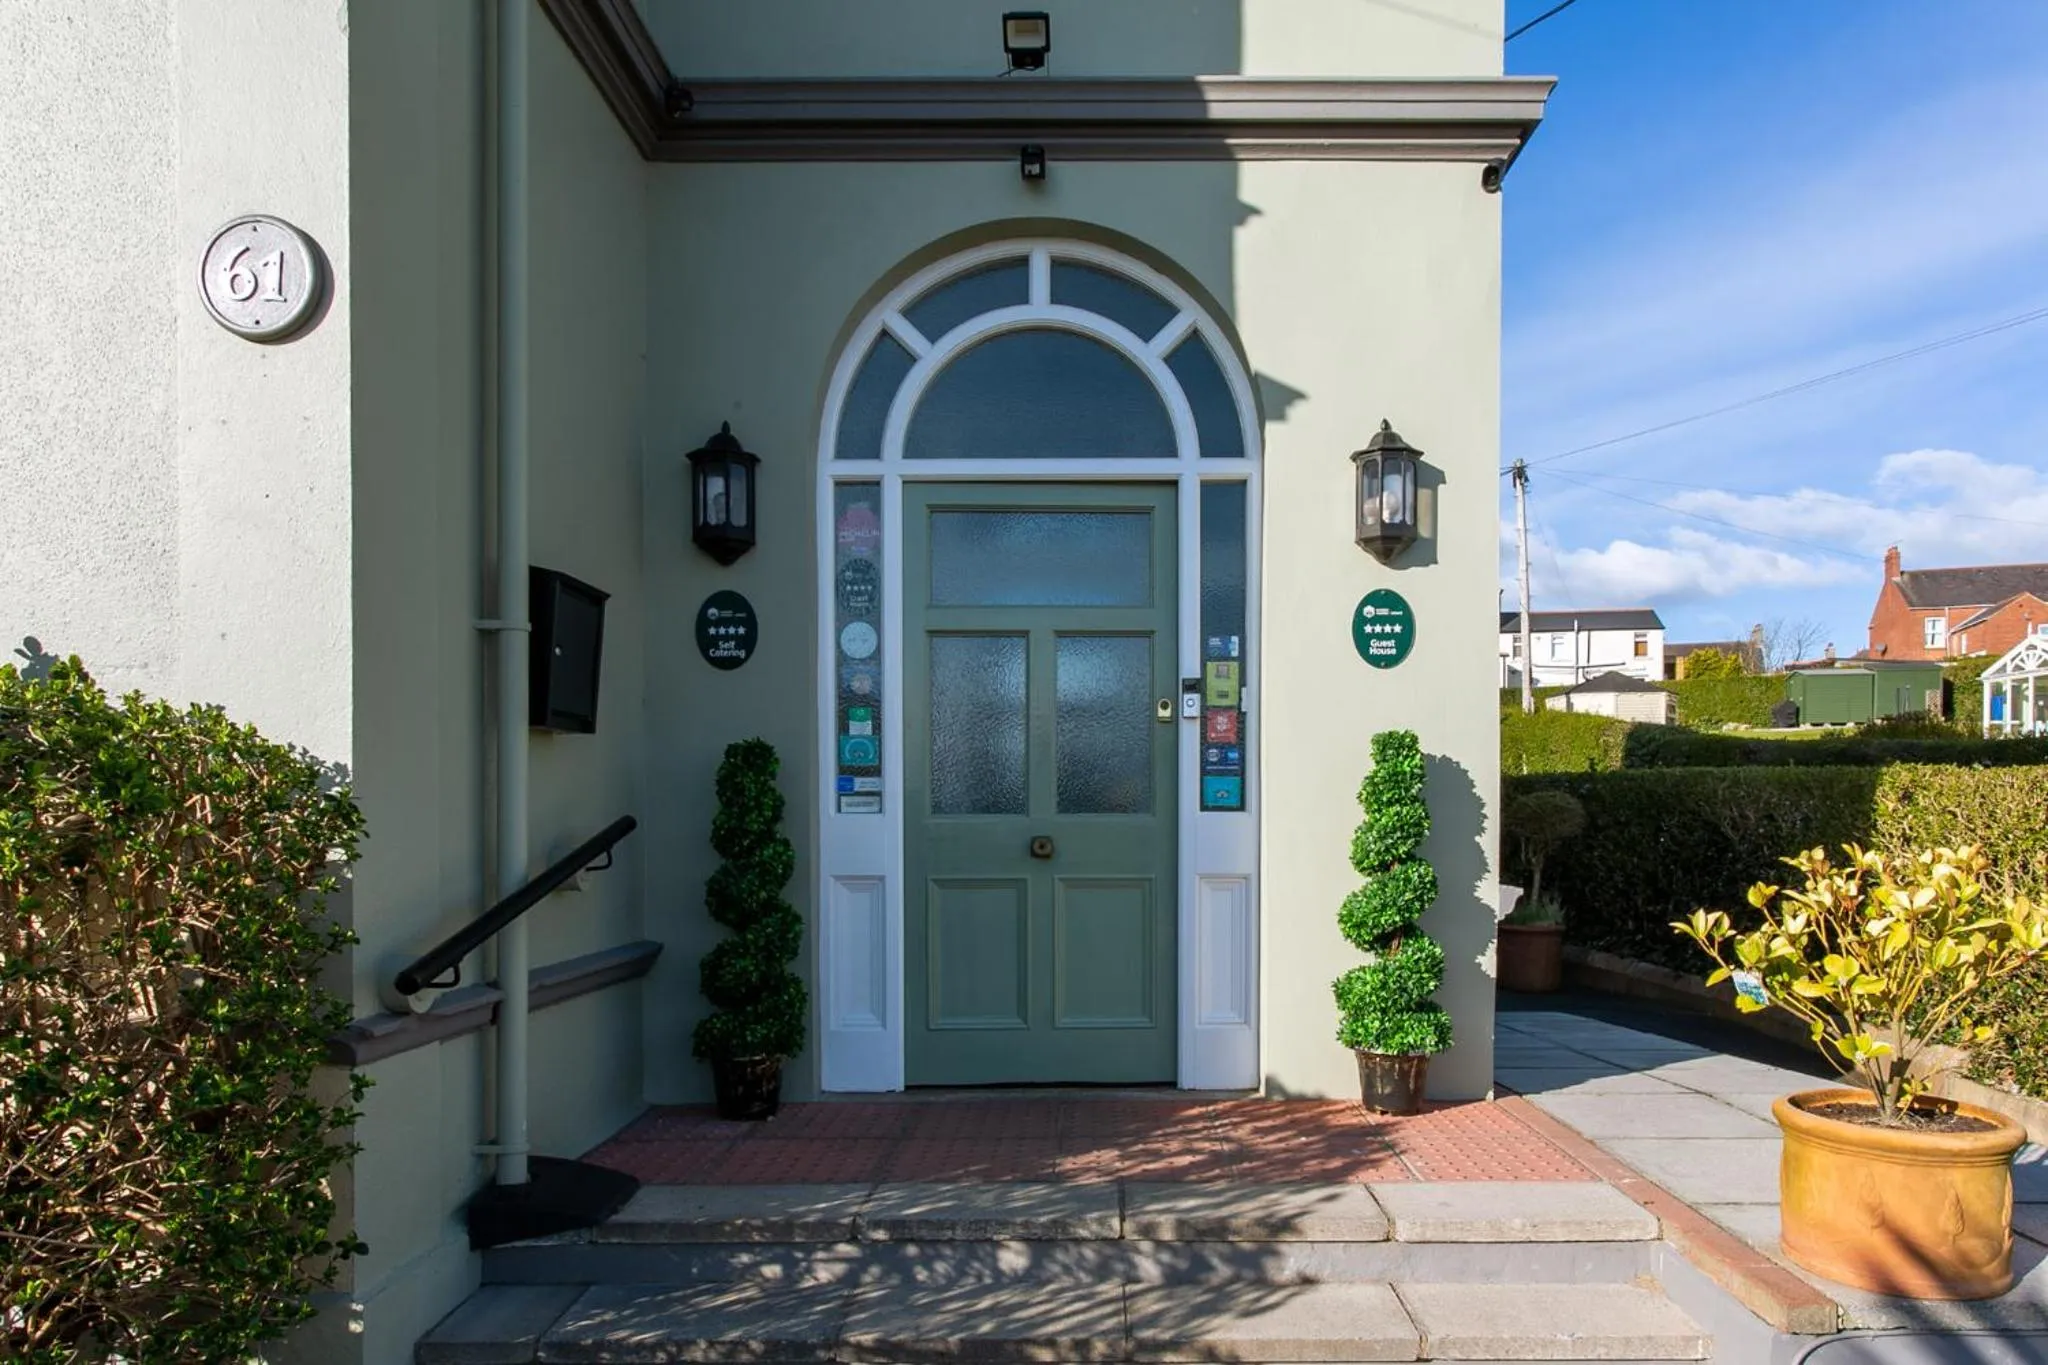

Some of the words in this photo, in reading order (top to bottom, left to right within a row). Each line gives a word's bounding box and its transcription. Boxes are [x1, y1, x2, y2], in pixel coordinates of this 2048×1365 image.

[221, 246, 287, 302] 61
[719, 641, 735, 649] Self
[1370, 639, 1396, 647] Guest
[709, 648, 746, 659] Catering
[1369, 647, 1397, 655] House
